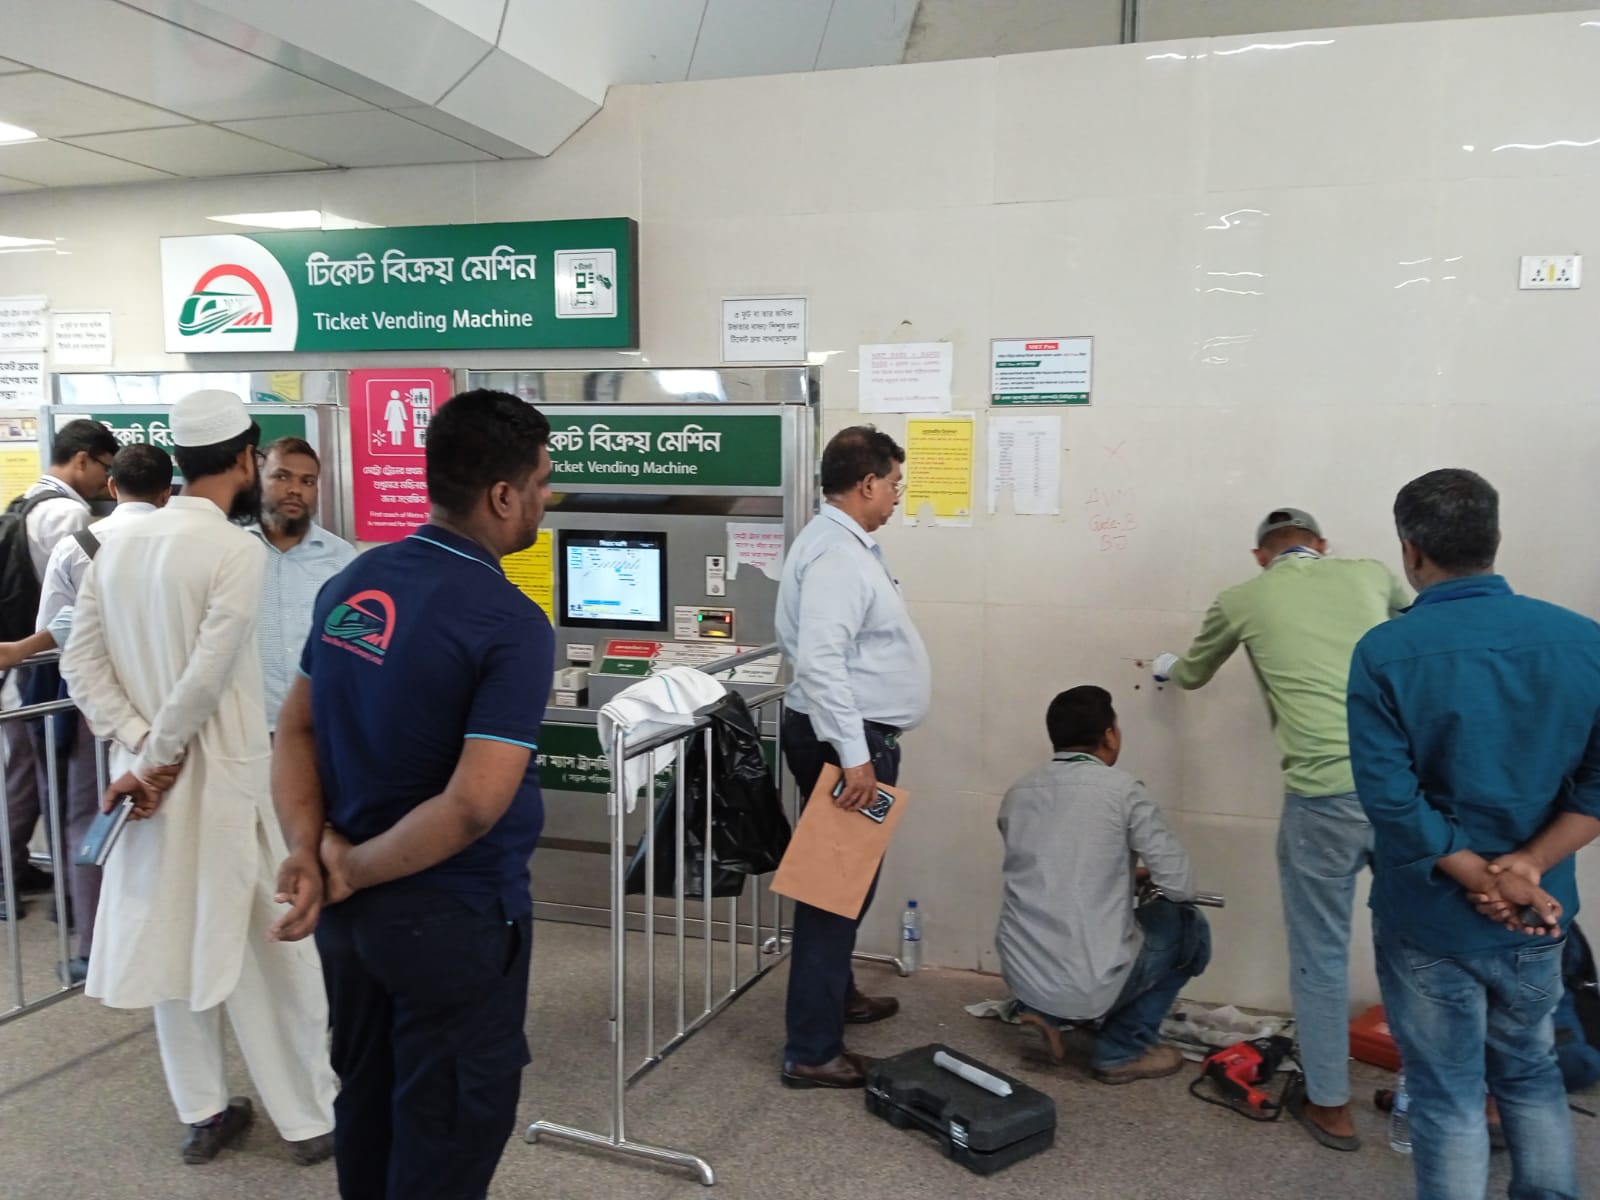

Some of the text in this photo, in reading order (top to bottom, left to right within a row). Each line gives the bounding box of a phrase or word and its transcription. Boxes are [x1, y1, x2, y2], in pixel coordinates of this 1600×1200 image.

[306, 245, 537, 286] টিকেট বিক্রয় মেশিন
[314, 307, 533, 332] Ticket Vending Machine
[588, 424, 651, 453] বিক্রয়
[657, 424, 721, 452] মেশিন
[588, 461, 640, 476] Vending
[643, 461, 698, 474] Machine
